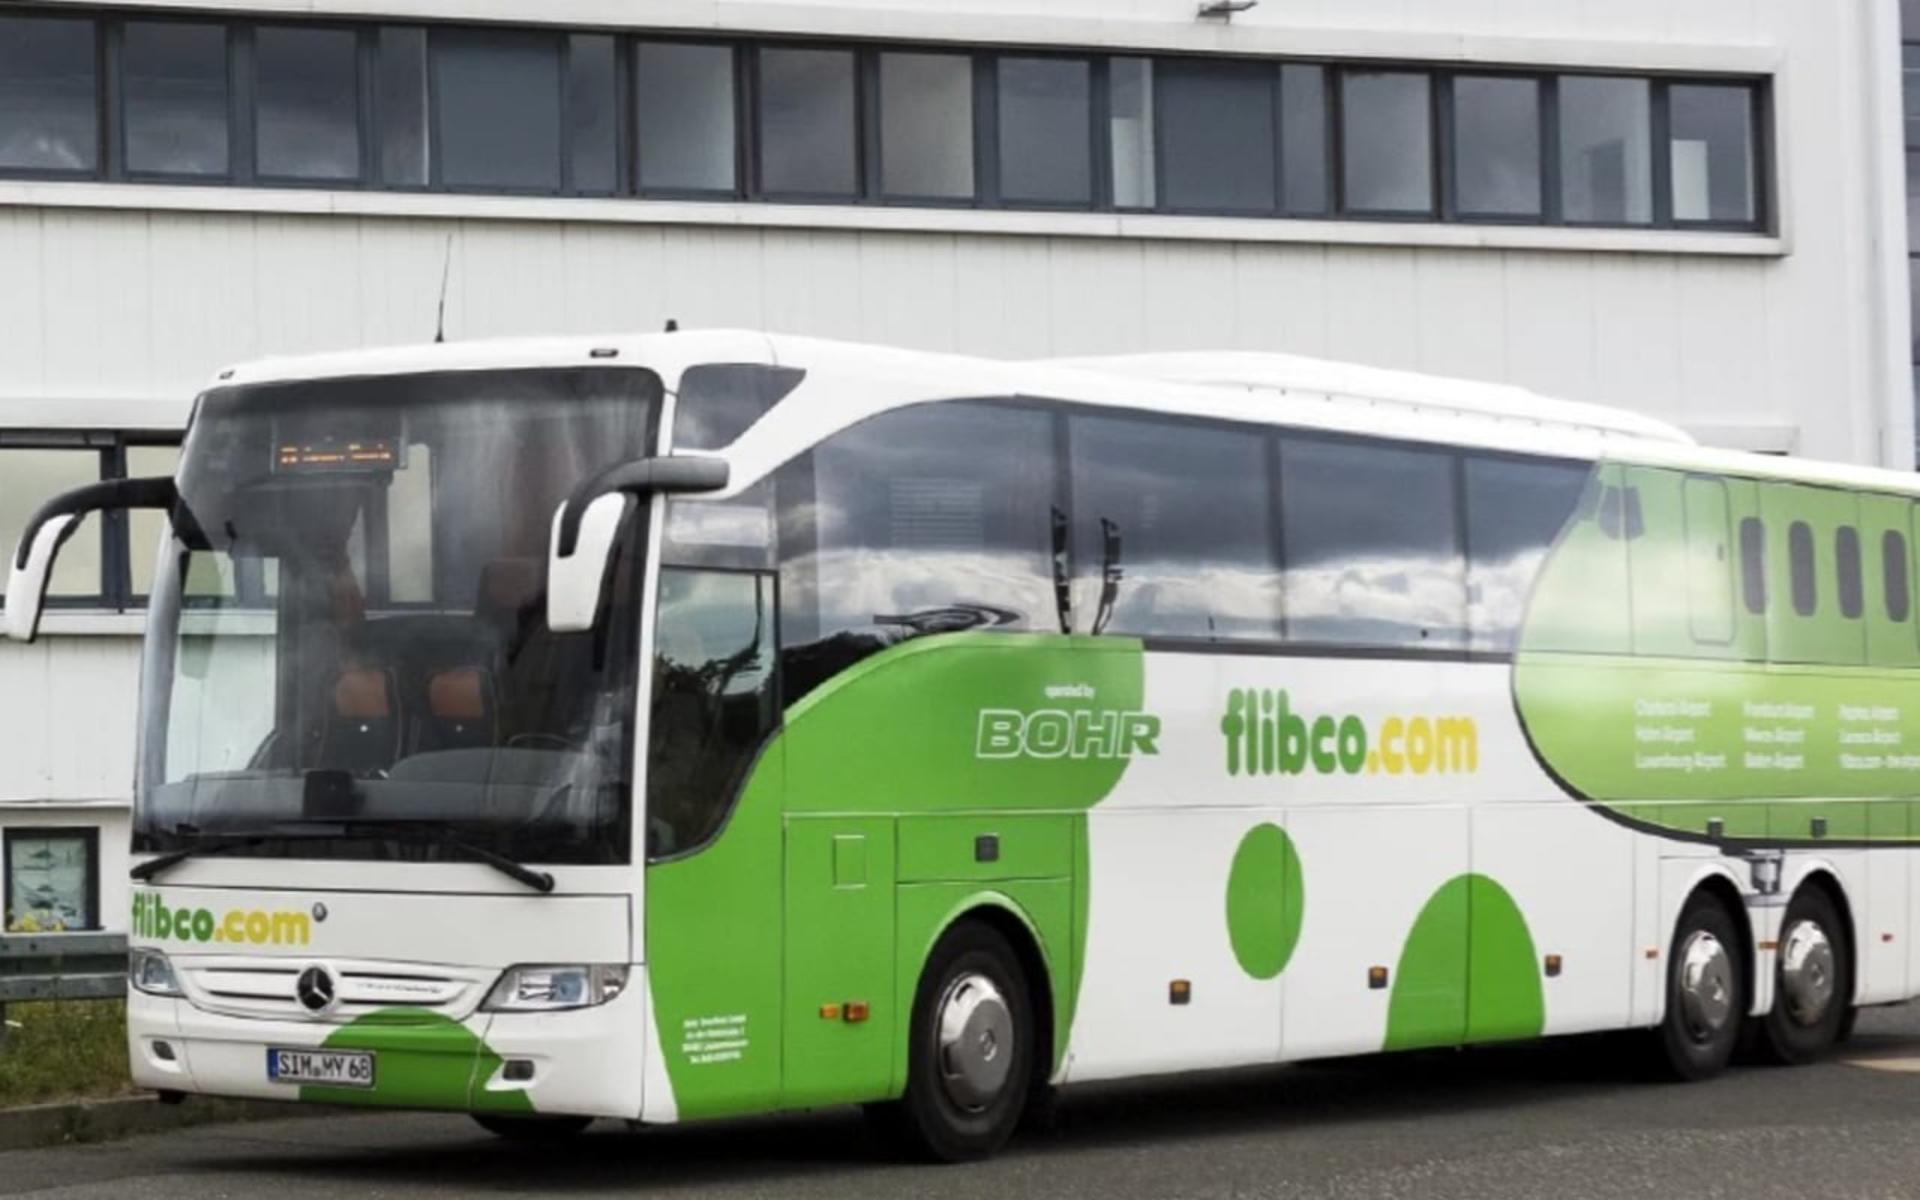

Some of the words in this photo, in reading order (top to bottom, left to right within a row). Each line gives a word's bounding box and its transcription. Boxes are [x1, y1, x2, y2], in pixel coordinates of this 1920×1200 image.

[976, 709, 1160, 758] BOHR
[1220, 688, 1478, 776] flibco.com
[131, 892, 311, 945] flibco.com
[279, 1053, 314, 1076] SIM
[349, 1057, 372, 1080] 68
